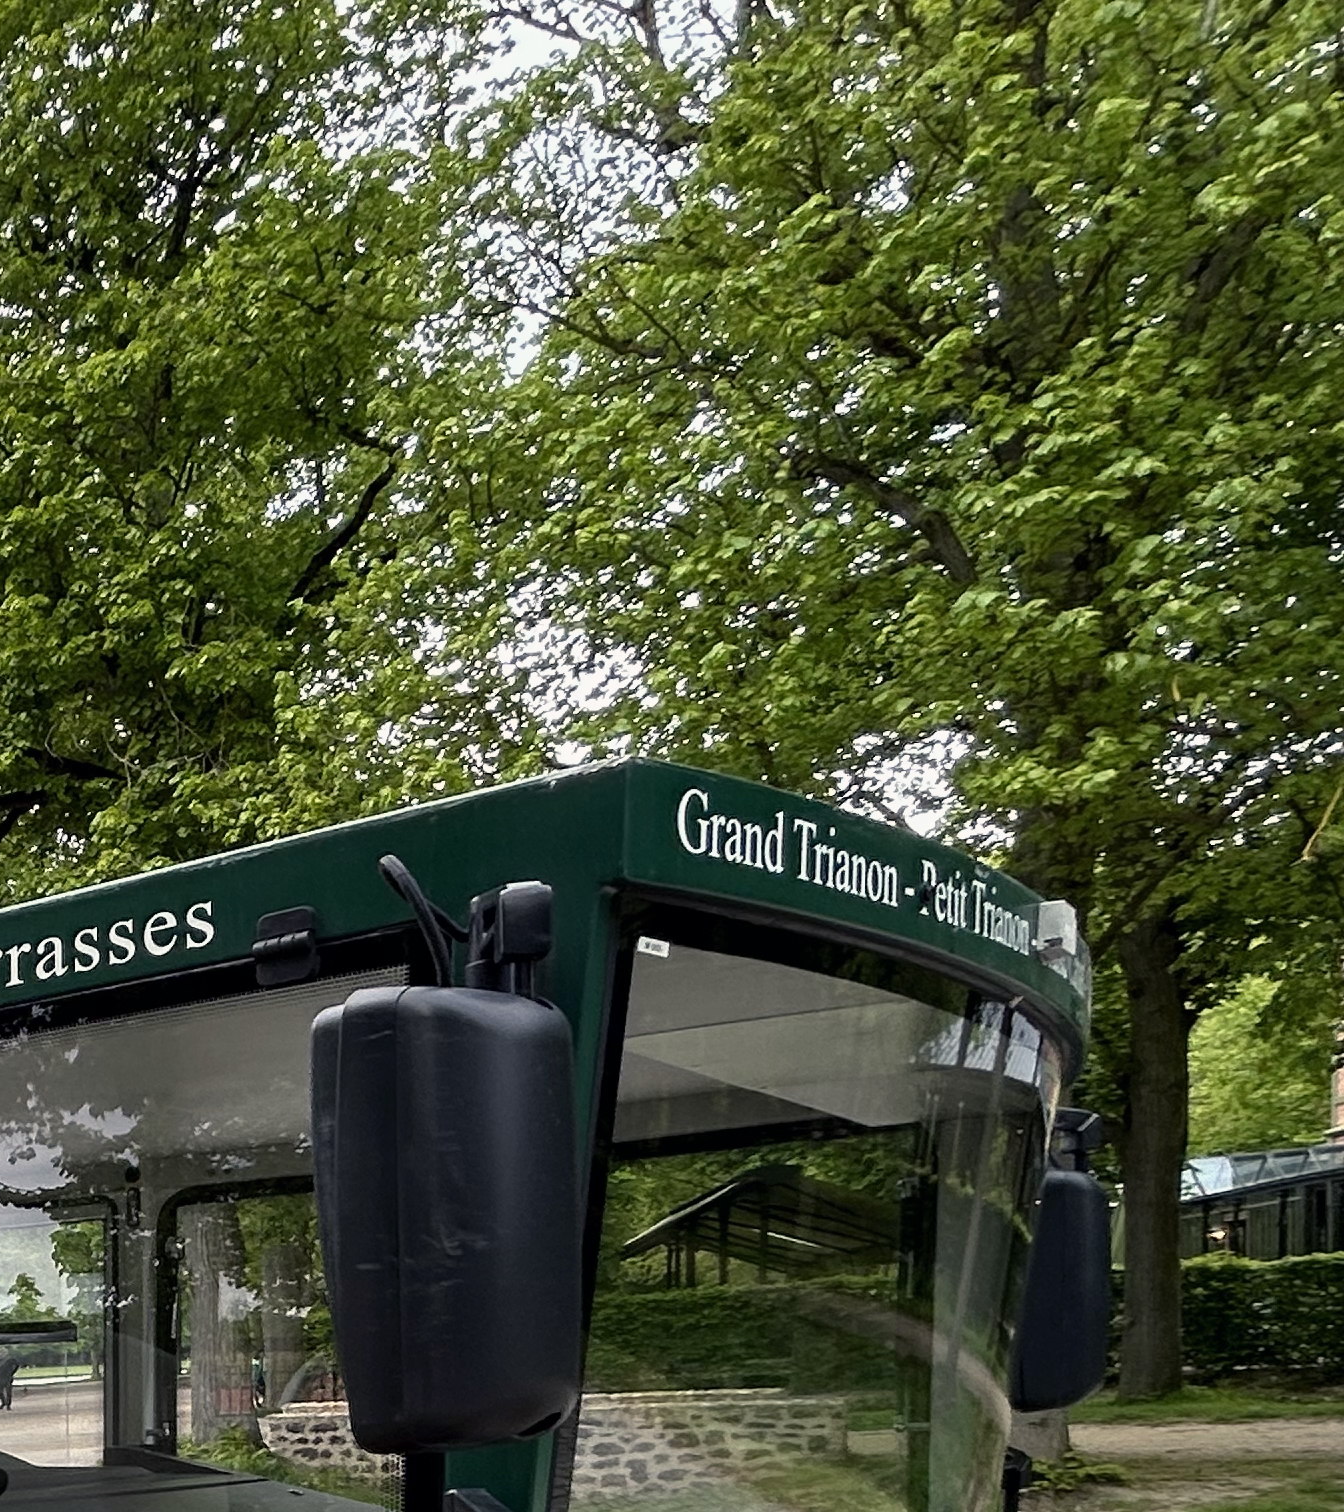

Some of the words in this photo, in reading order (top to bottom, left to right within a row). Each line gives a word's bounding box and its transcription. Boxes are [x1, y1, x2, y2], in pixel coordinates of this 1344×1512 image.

[676, 788, 784, 874] Grand
[793, 817, 899, 908] Trianon
[919, 858, 968, 928] Petit
